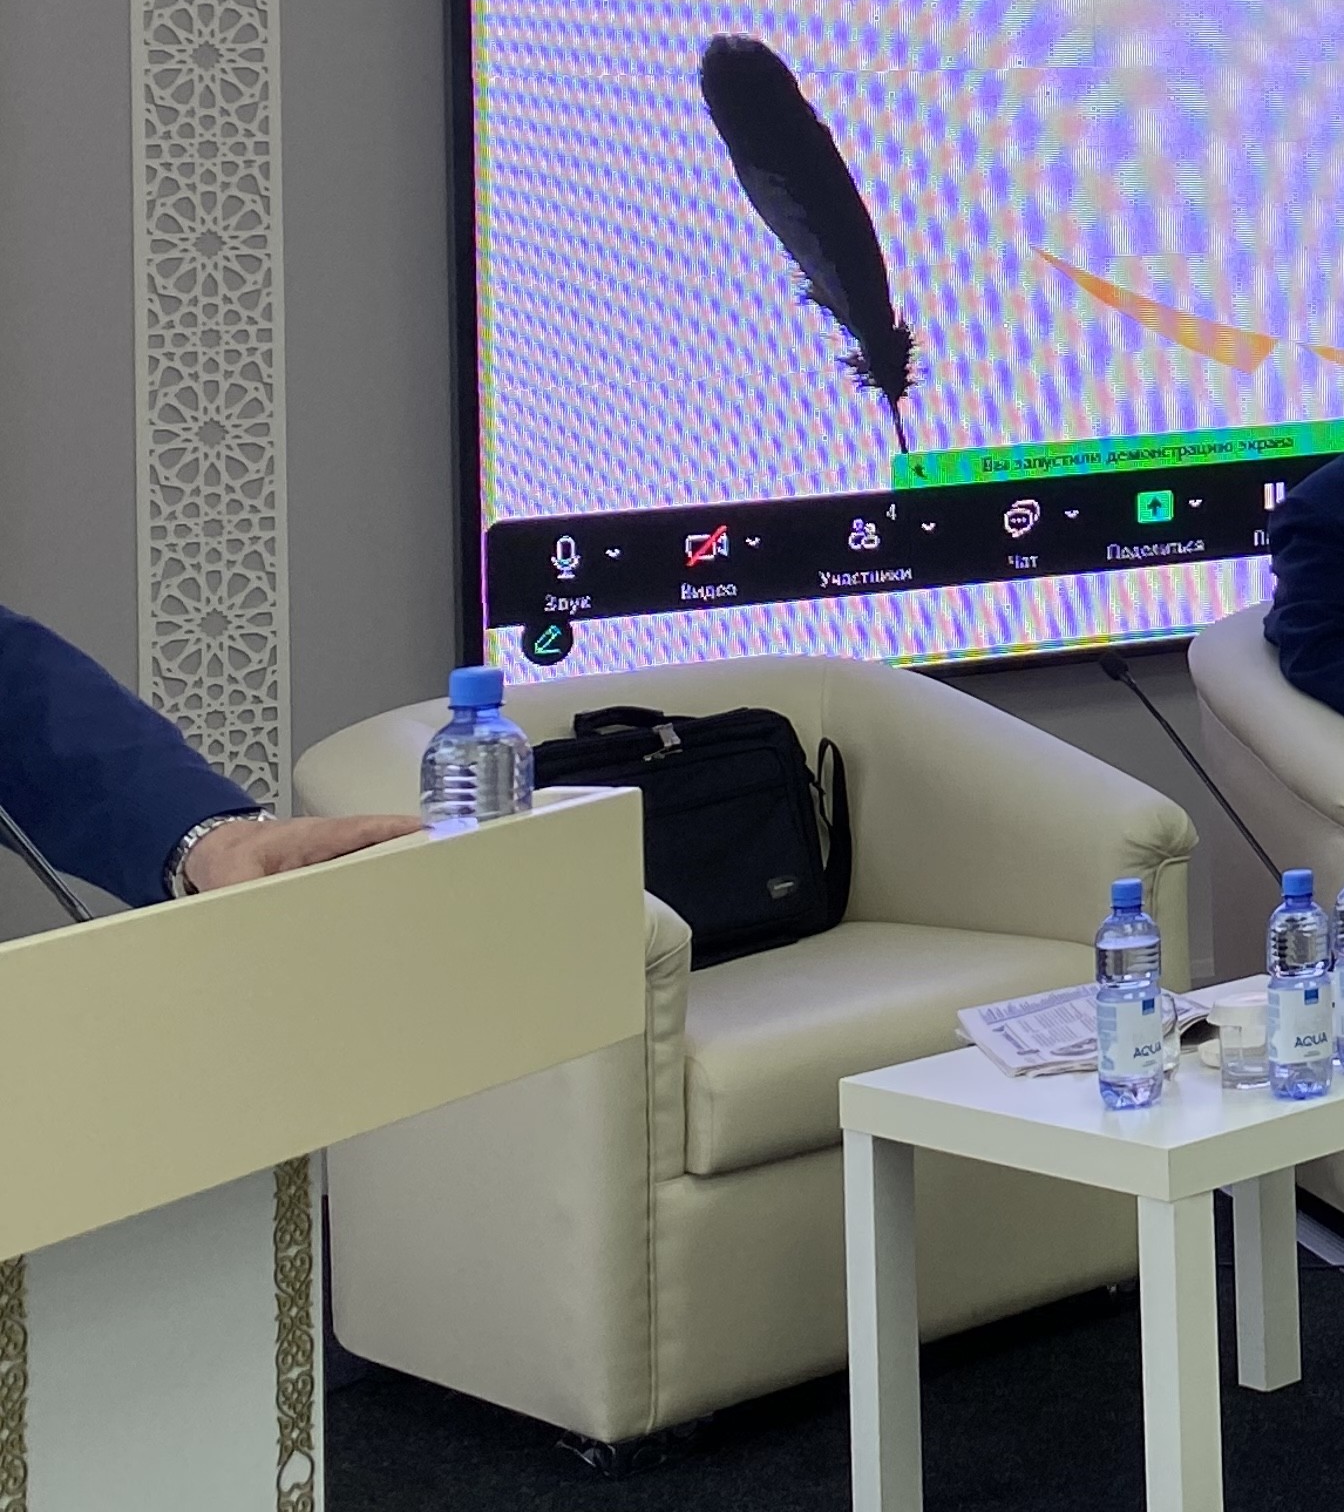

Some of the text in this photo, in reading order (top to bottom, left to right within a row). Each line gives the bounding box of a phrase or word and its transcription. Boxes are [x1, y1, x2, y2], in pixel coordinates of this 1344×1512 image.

[1013, 450, 1101, 473] запустили
[1106, 441, 1234, 465] демонстрацию
[1106, 539, 1205, 560] Поделиться
[1008, 554, 1038, 570] Чат
[818, 568, 912, 588] Участники
[680, 582, 738, 602] Видео
[544, 593, 591, 615] Звук
[1294, 1031, 1328, 1048] AQUA
